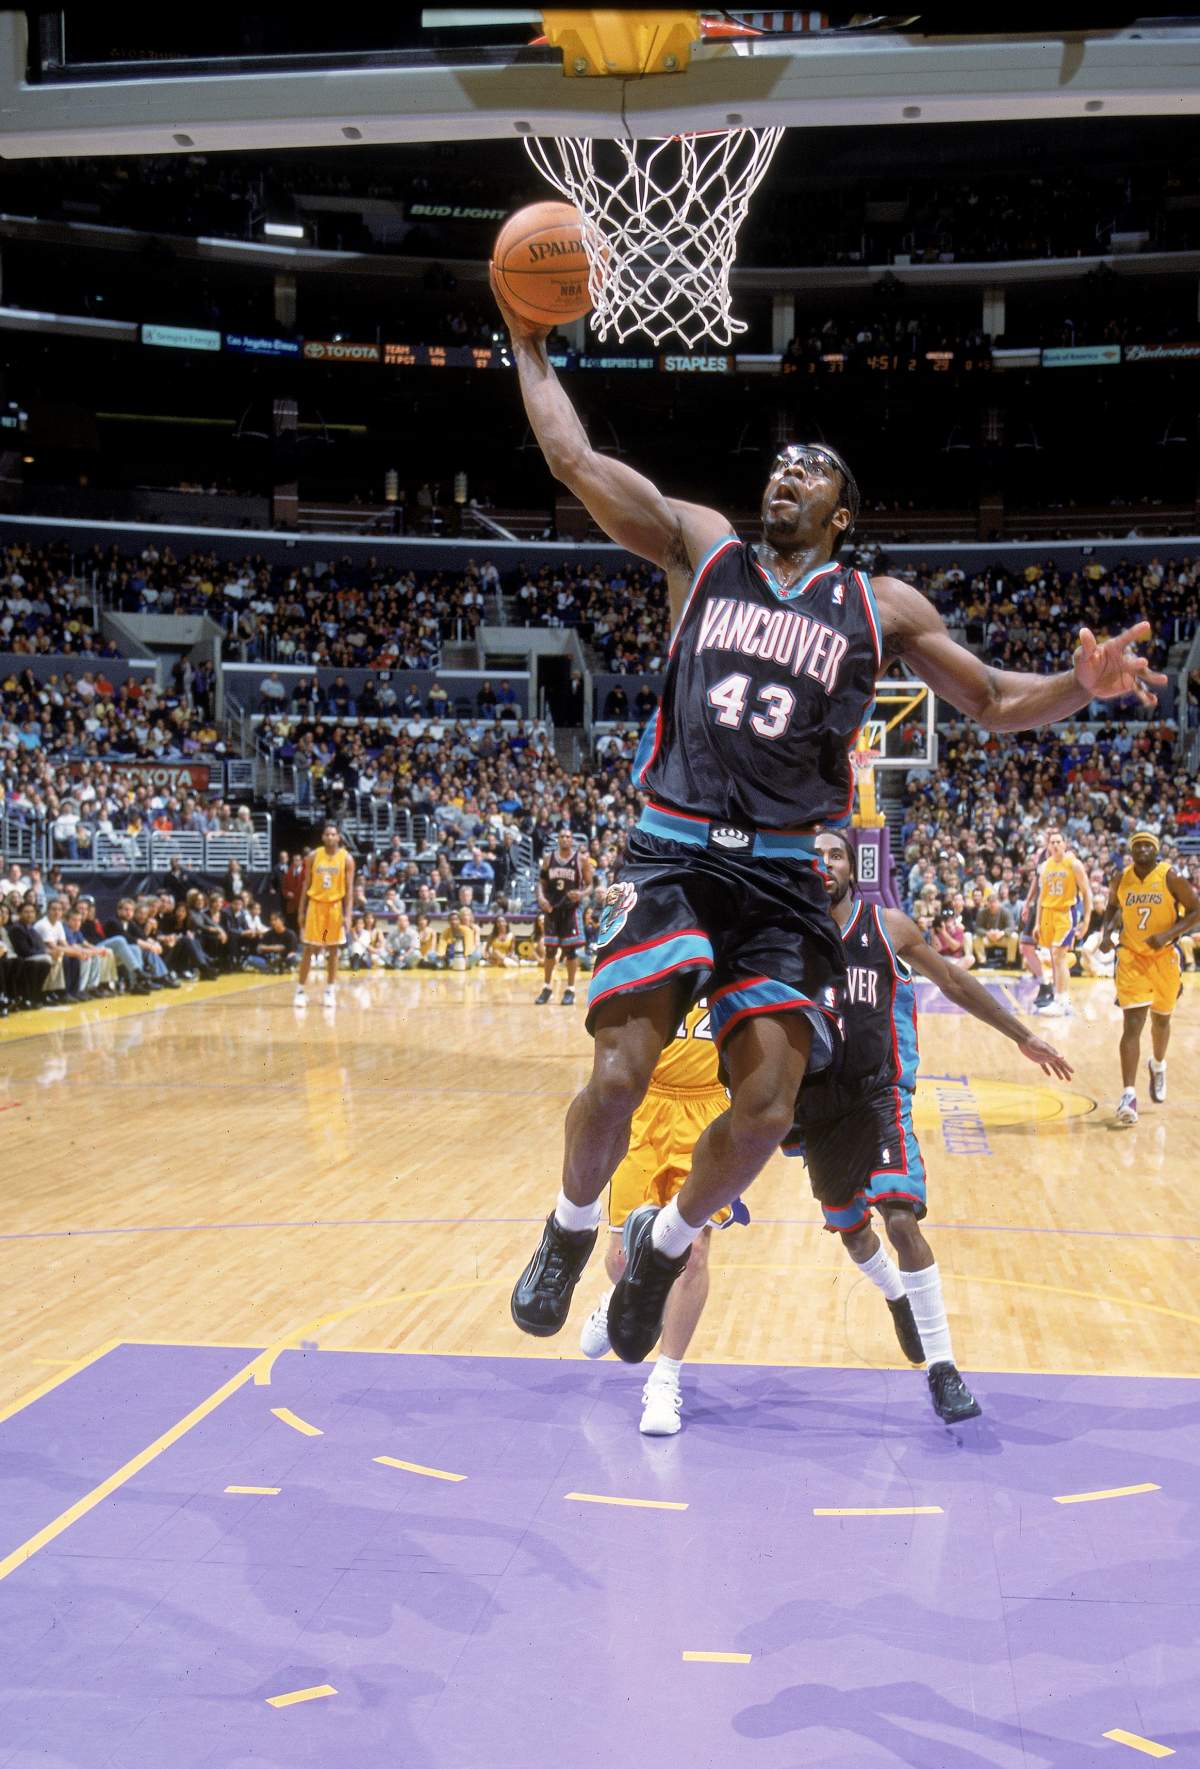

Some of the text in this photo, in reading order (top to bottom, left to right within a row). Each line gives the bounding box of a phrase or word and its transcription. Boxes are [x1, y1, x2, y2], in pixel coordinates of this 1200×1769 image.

[410, 205, 508, 219] BUD LIGHT
[529, 240, 586, 263] SPALDI
[560, 284, 582, 297] NBA
[327, 345, 379, 359] TOYOTA
[665, 355, 728, 371] STAPLES
[695, 598, 849, 696] VANCOUVER
[707, 673, 796, 740] 43
[863, 848, 874, 879] MGD
[556, 879, 565, 891] 3
[1125, 892, 1164, 906] LAKERS
[1136, 907, 1151, 931] 7
